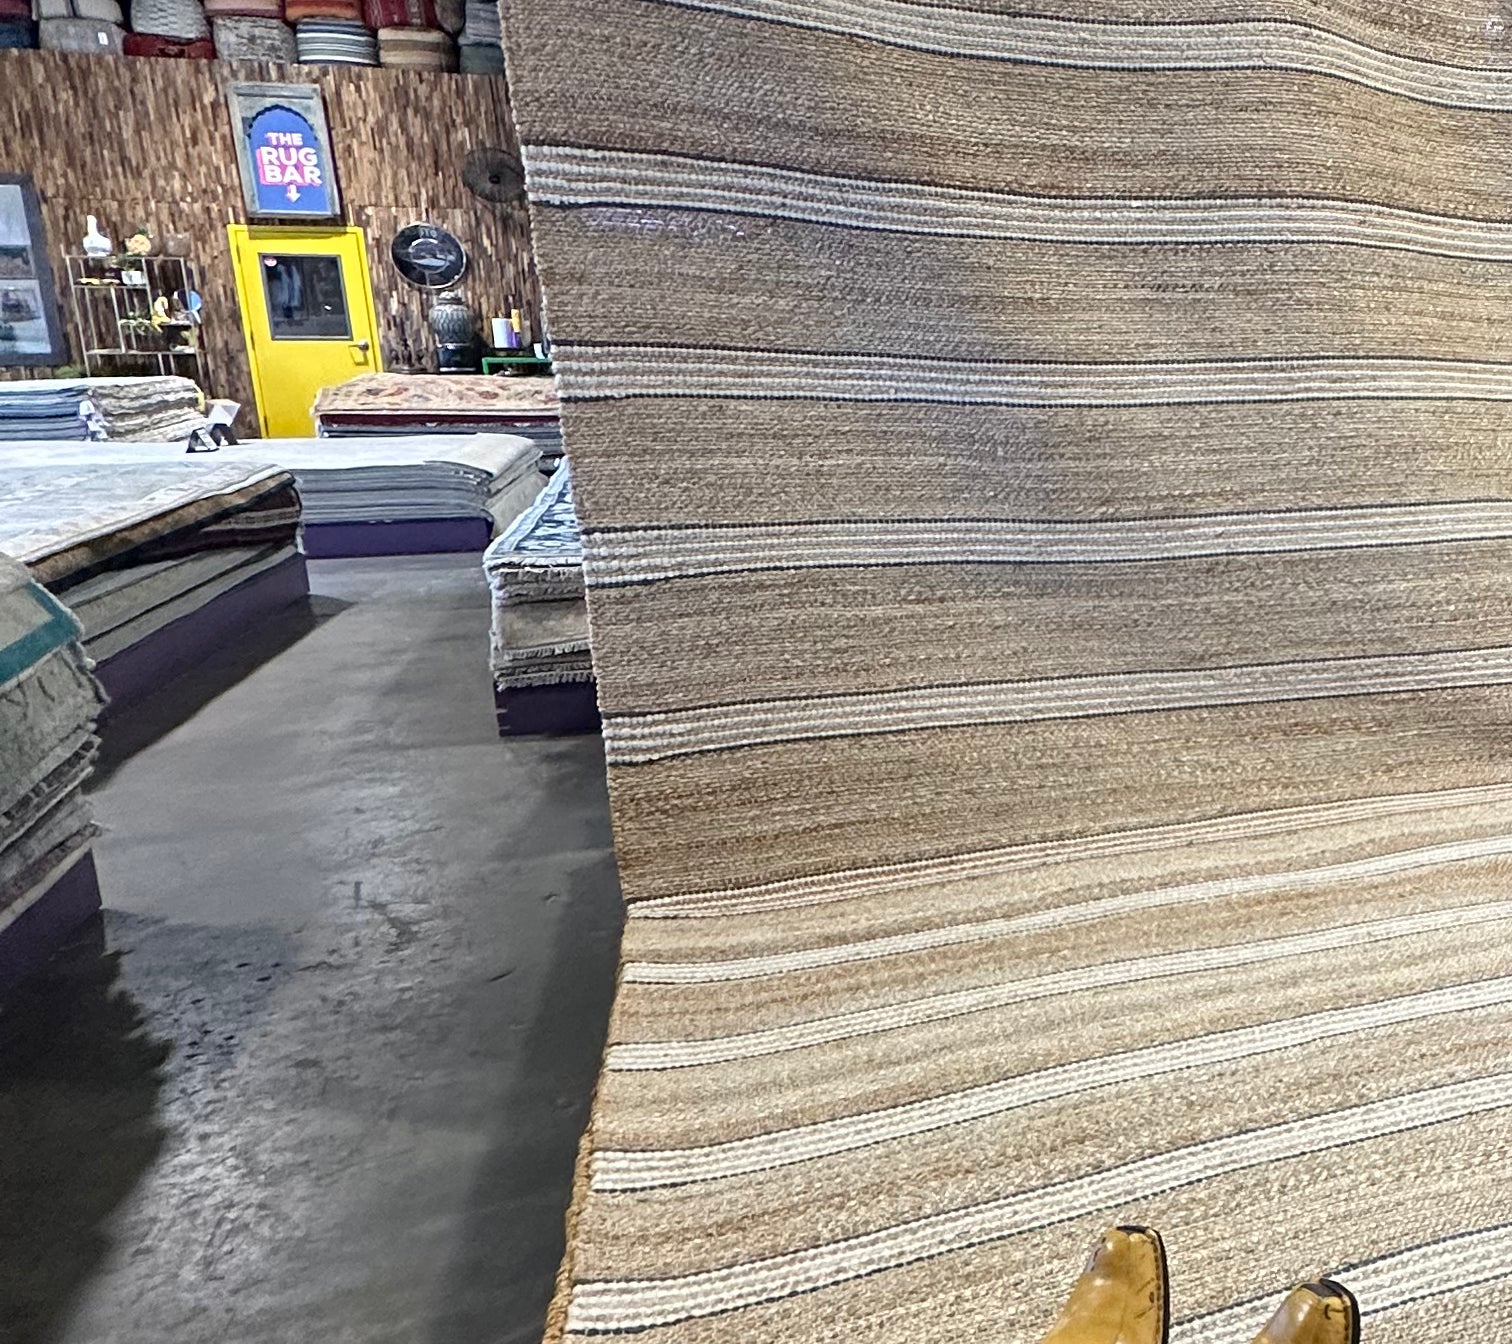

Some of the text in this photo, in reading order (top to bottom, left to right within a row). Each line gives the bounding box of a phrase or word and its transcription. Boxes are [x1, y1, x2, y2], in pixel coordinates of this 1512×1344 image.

[264, 132, 304, 146] THE
[257, 146, 318, 167] RUG
[260, 165, 322, 186] BAR
